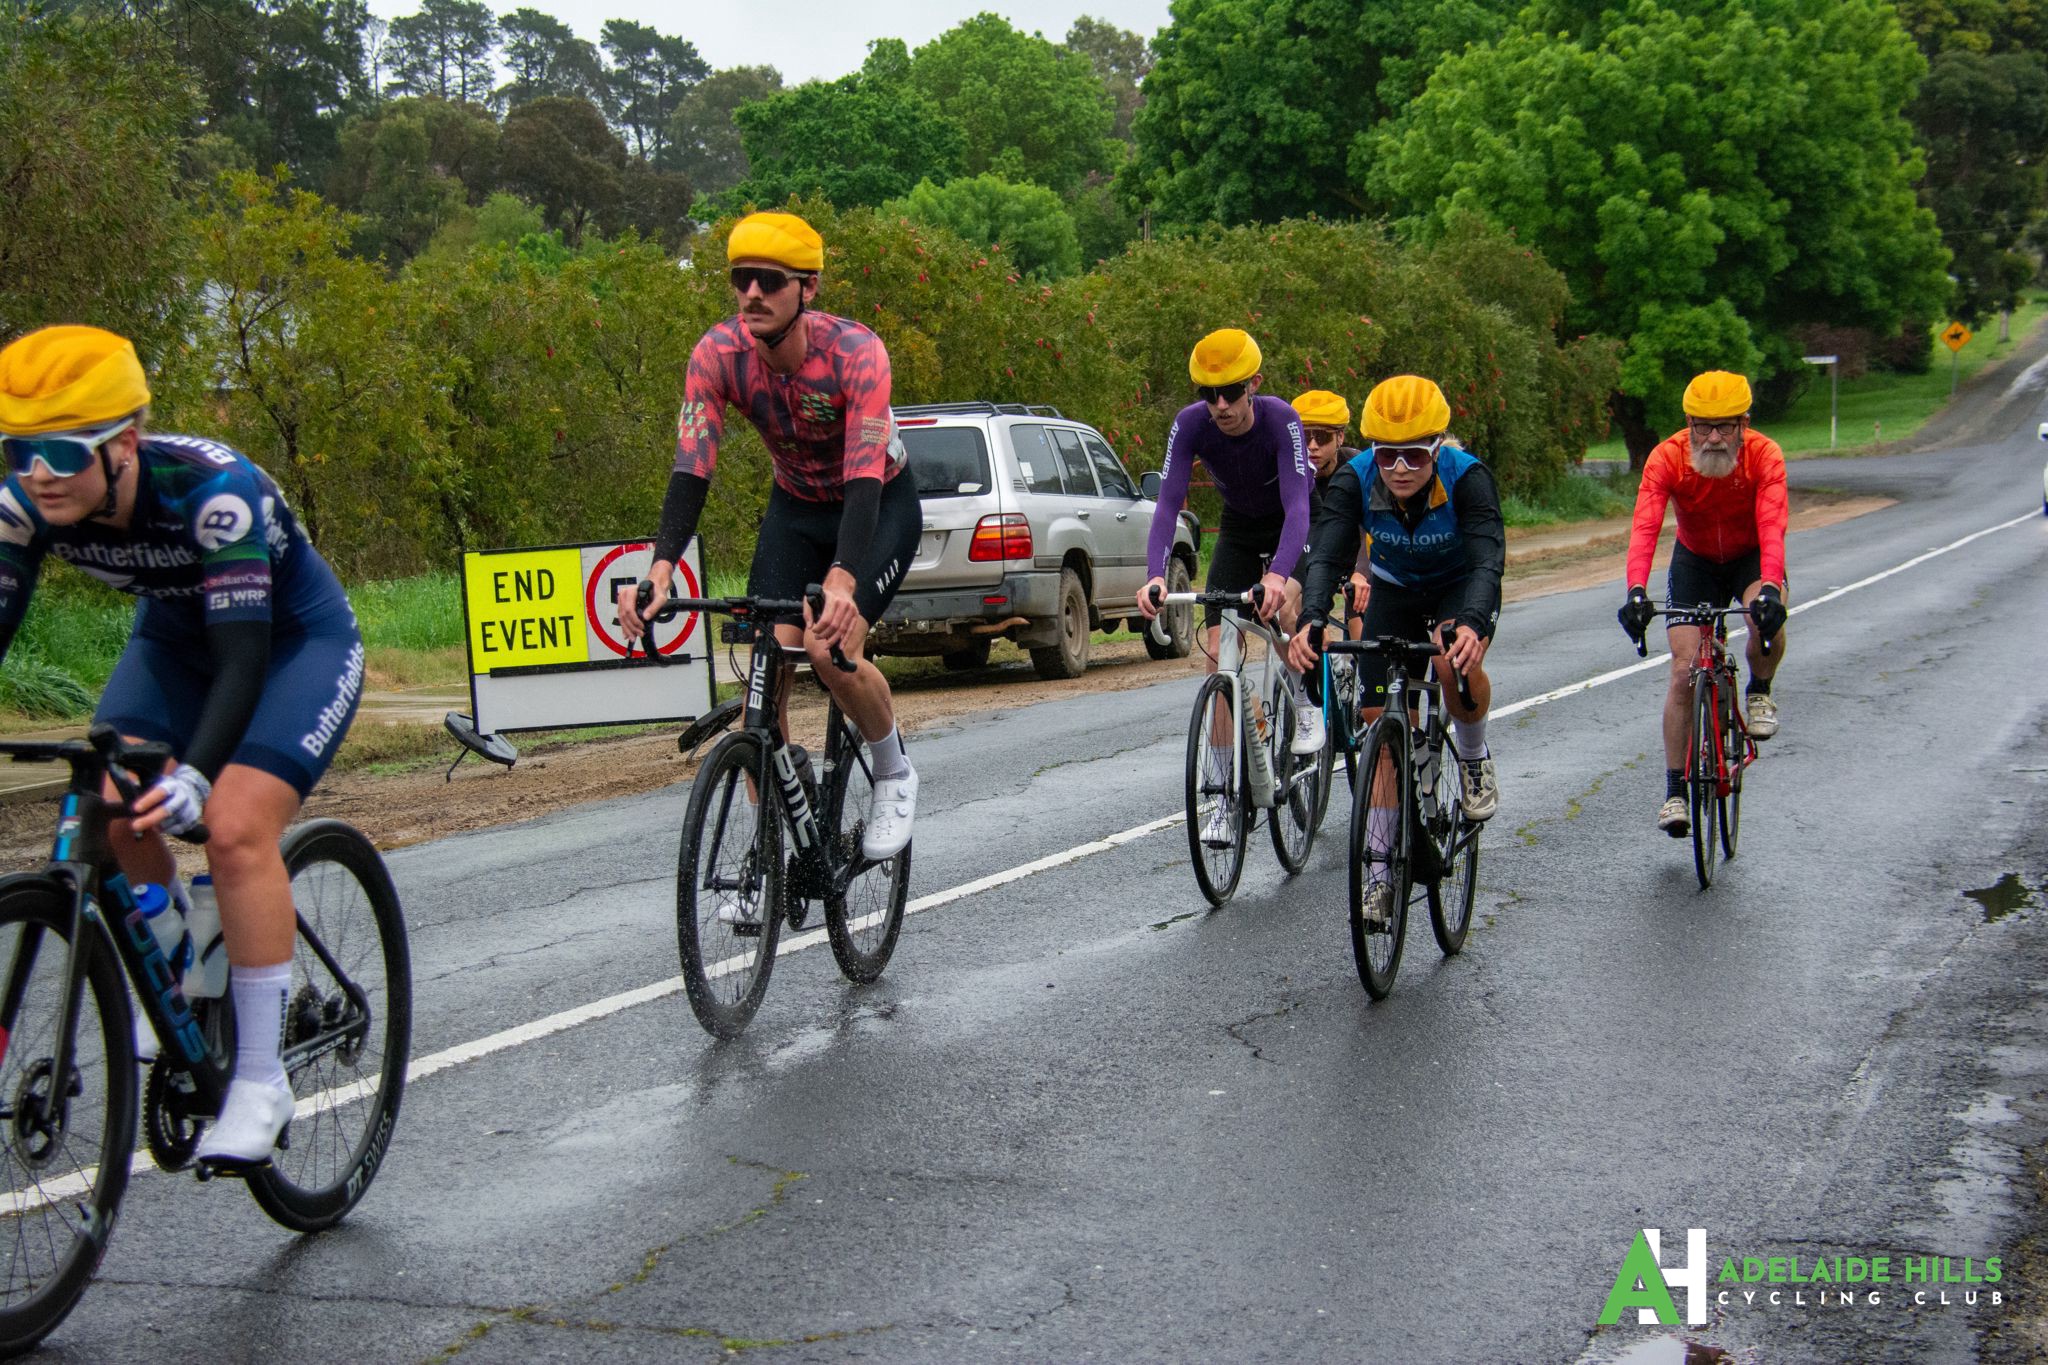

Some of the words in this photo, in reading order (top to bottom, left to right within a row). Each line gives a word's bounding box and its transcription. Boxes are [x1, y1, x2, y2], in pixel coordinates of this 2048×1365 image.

[1161, 421, 1180, 480] ATTAQUER
[1286, 421, 1306, 477] ATTAQUER
[1369, 526, 1456, 548] keystone
[232, 590, 268, 602] WRP
[493, 568, 555, 604] END
[480, 615, 575, 653] EVENT
[301, 641, 366, 759] Butterfields
[748, 652, 768, 711] BMC
[347, 1165, 366, 1201] DT
[364, 1110, 392, 1176] SWISS
